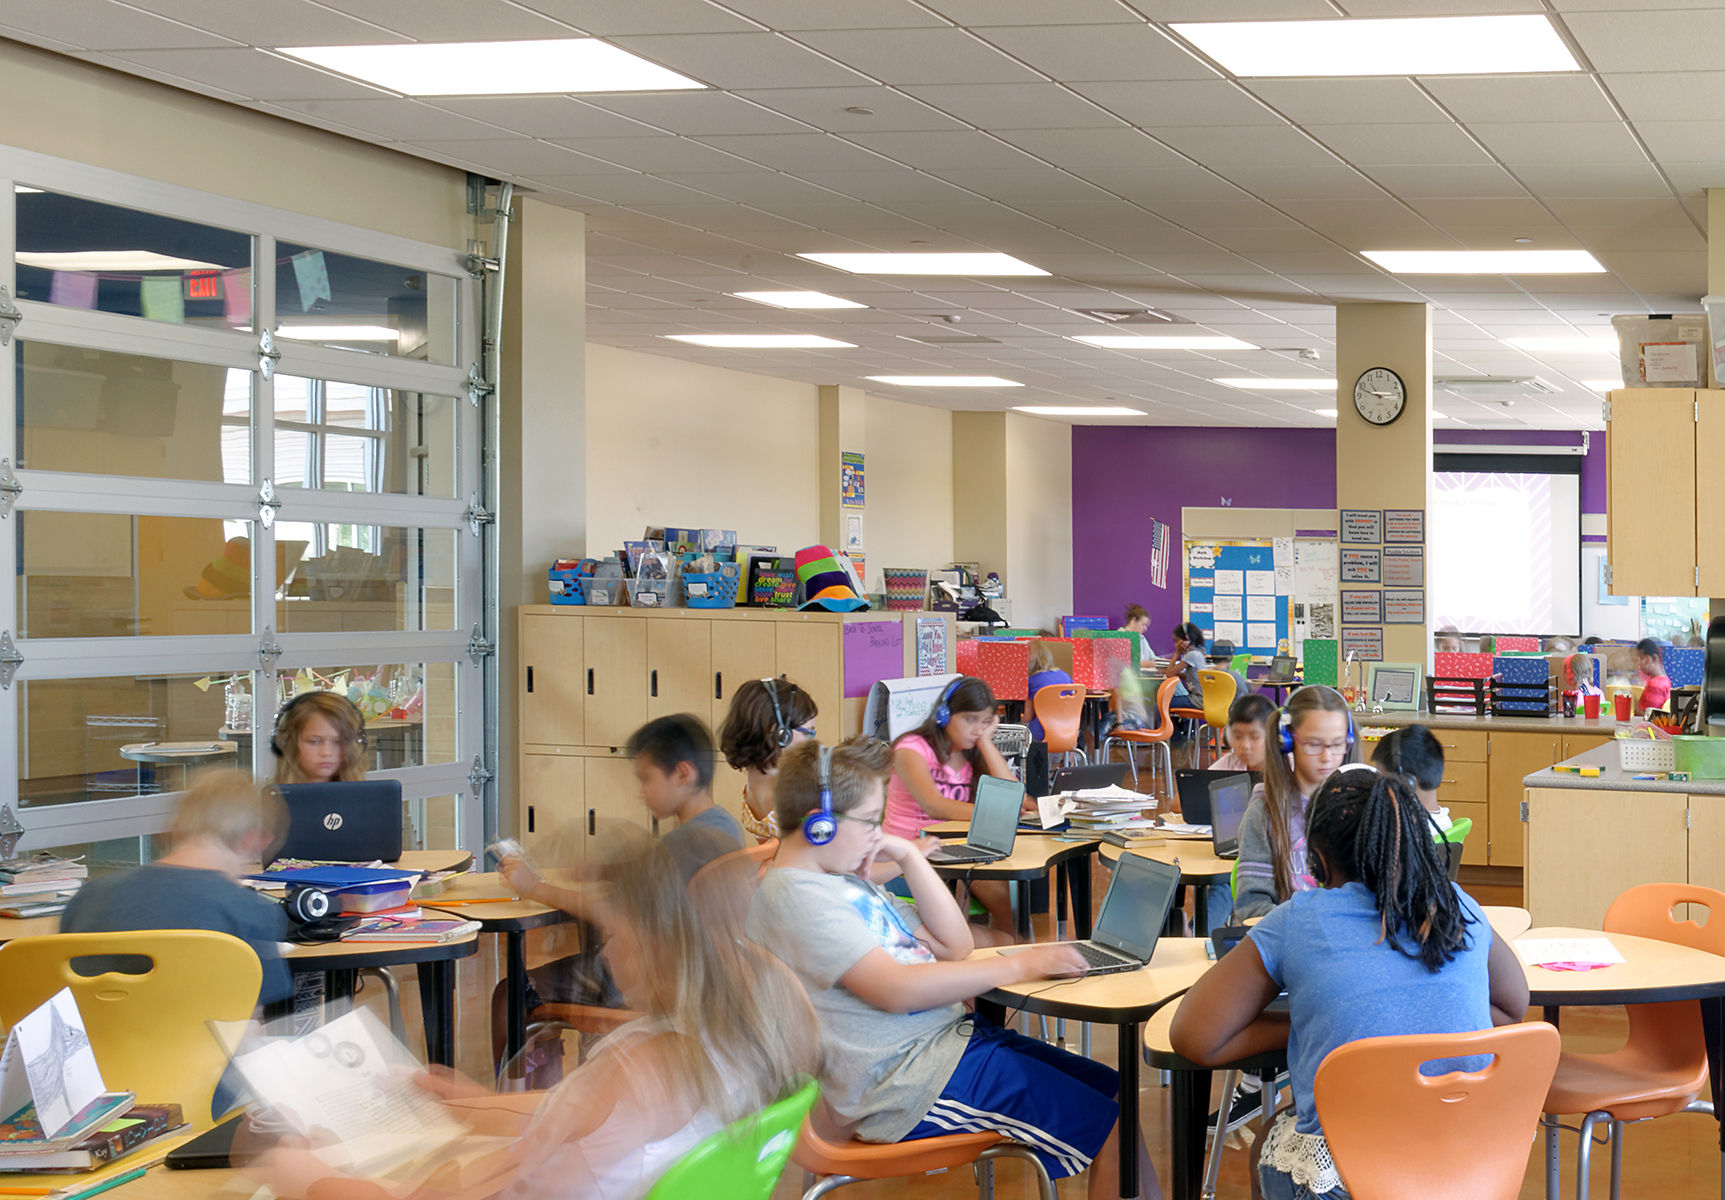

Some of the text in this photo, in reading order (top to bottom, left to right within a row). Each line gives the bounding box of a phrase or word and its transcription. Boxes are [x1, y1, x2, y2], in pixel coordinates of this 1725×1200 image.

[1359, 382, 1366, 390] 10
[1368, 411, 1373, 419] 7
[1387, 411, 1392, 419] 5
[325, 813, 341, 830] hp
[95, 1145, 109, 1159] Kay
